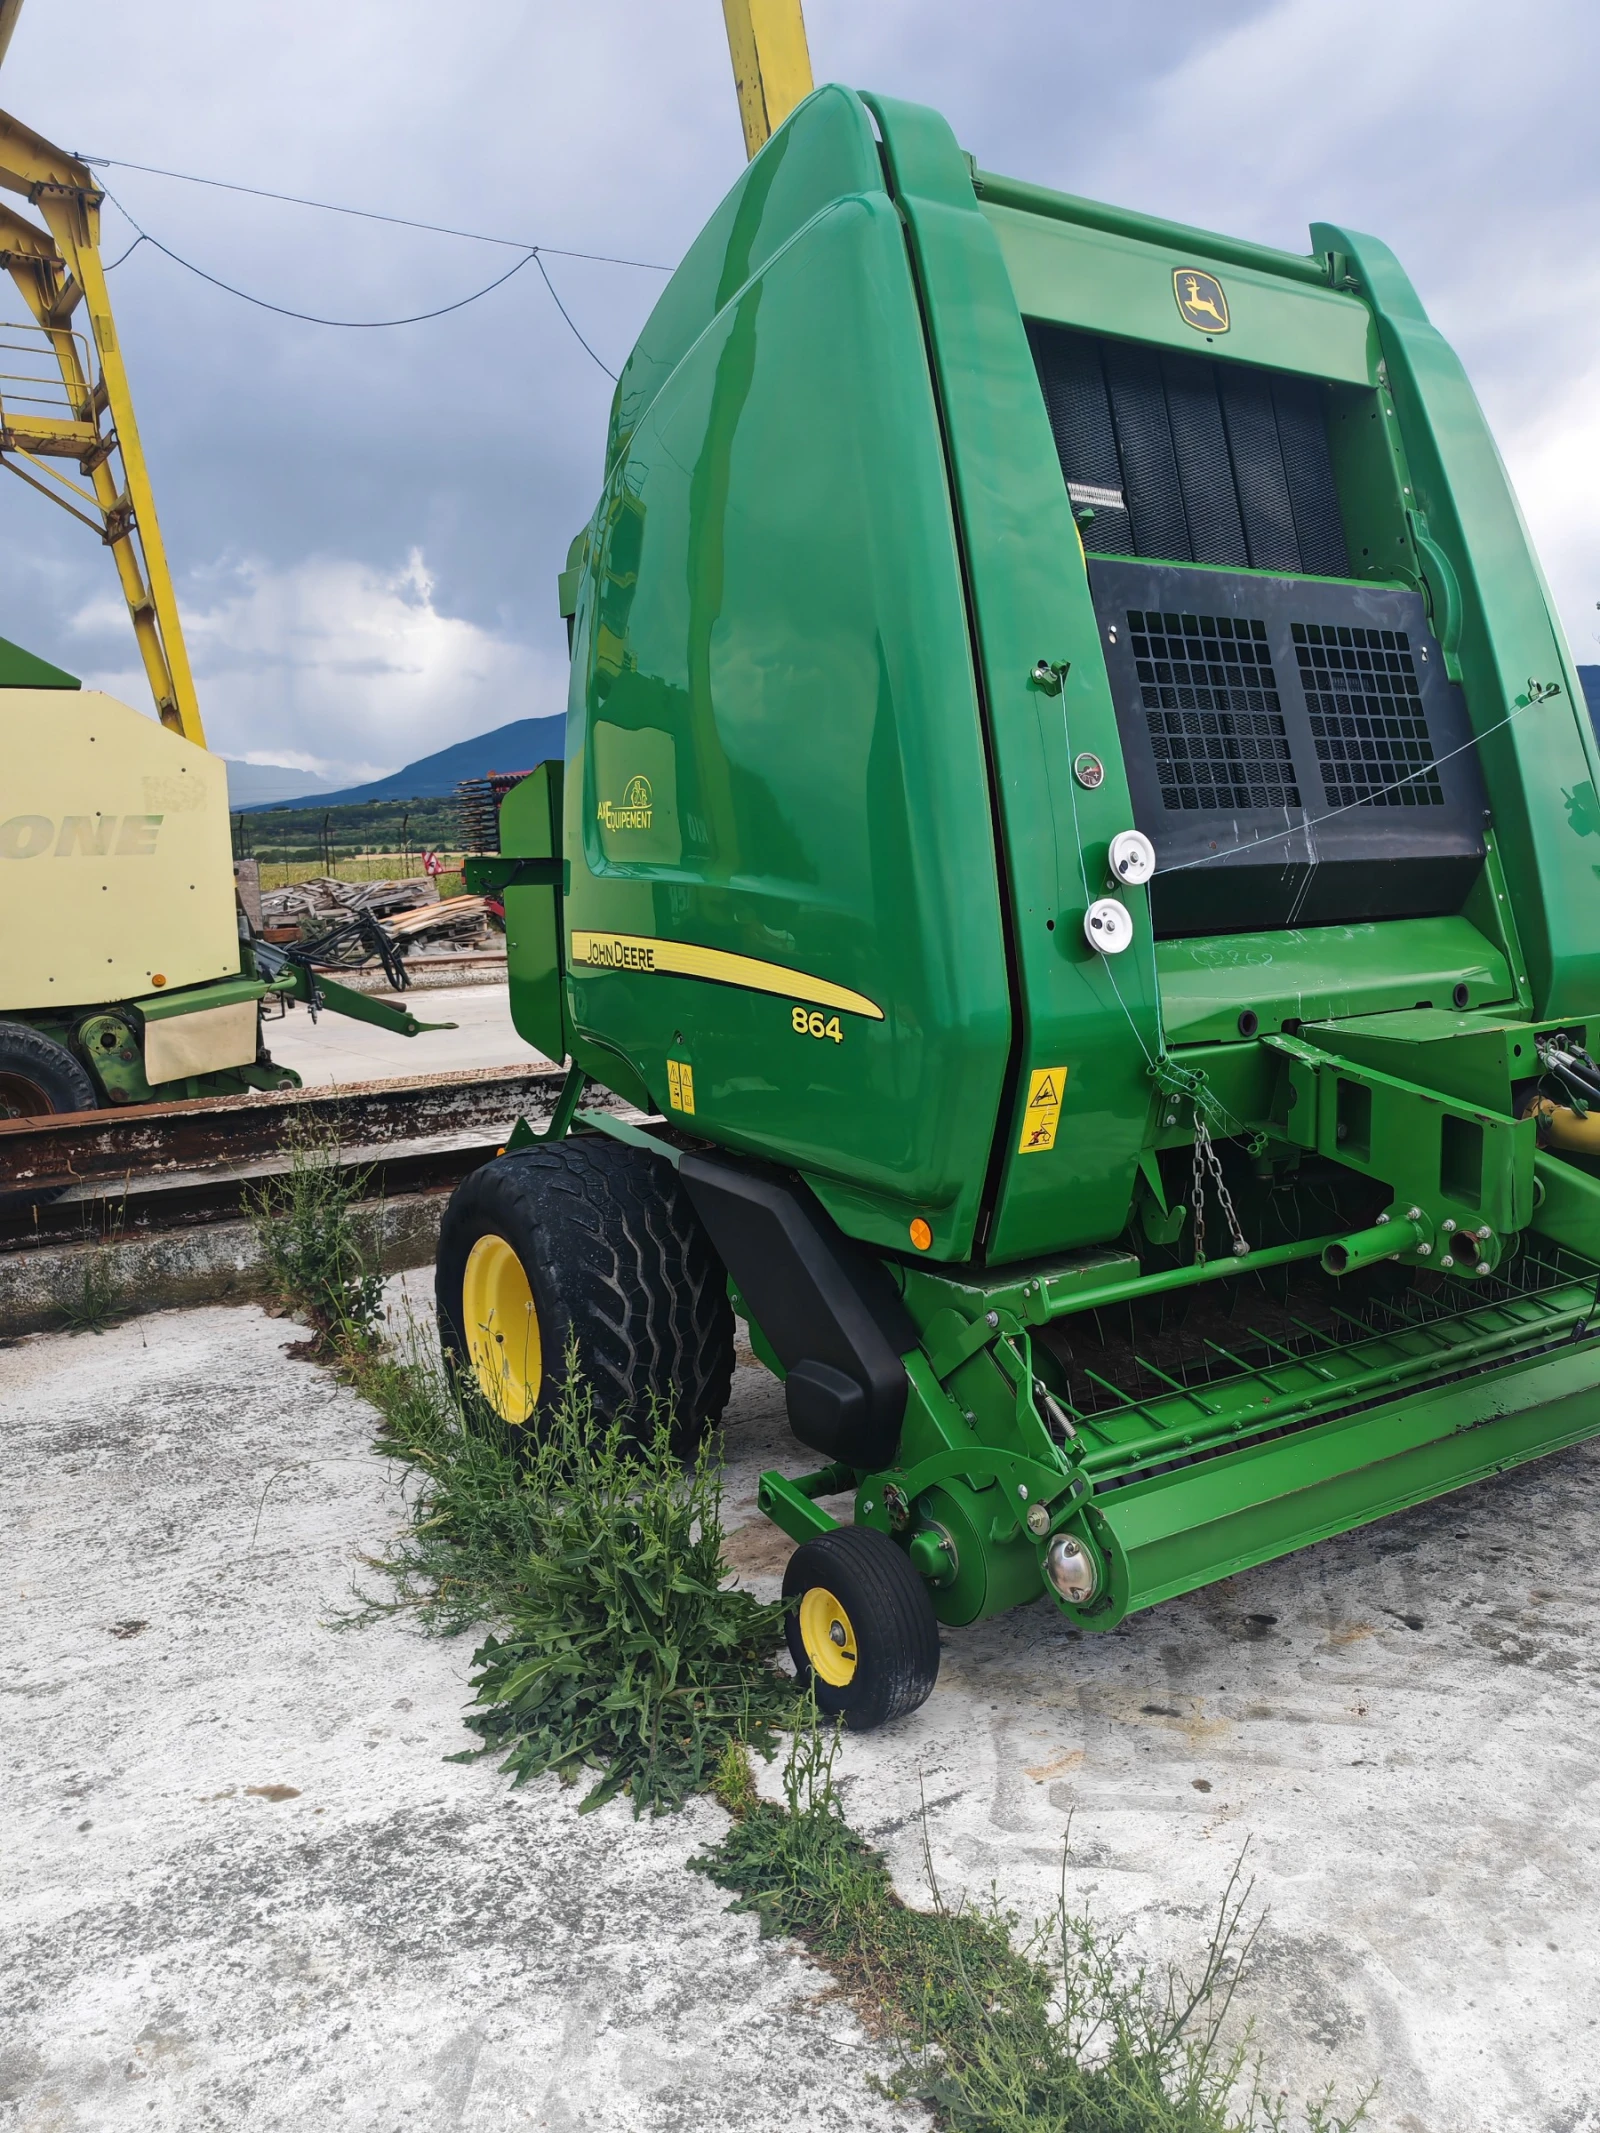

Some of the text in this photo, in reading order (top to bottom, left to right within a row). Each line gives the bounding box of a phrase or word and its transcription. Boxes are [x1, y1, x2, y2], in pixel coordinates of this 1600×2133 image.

[0, 815, 164, 859] ONE
[587, 939, 655, 969] JOHN DEERE
[791, 1006, 844, 1044] 864
